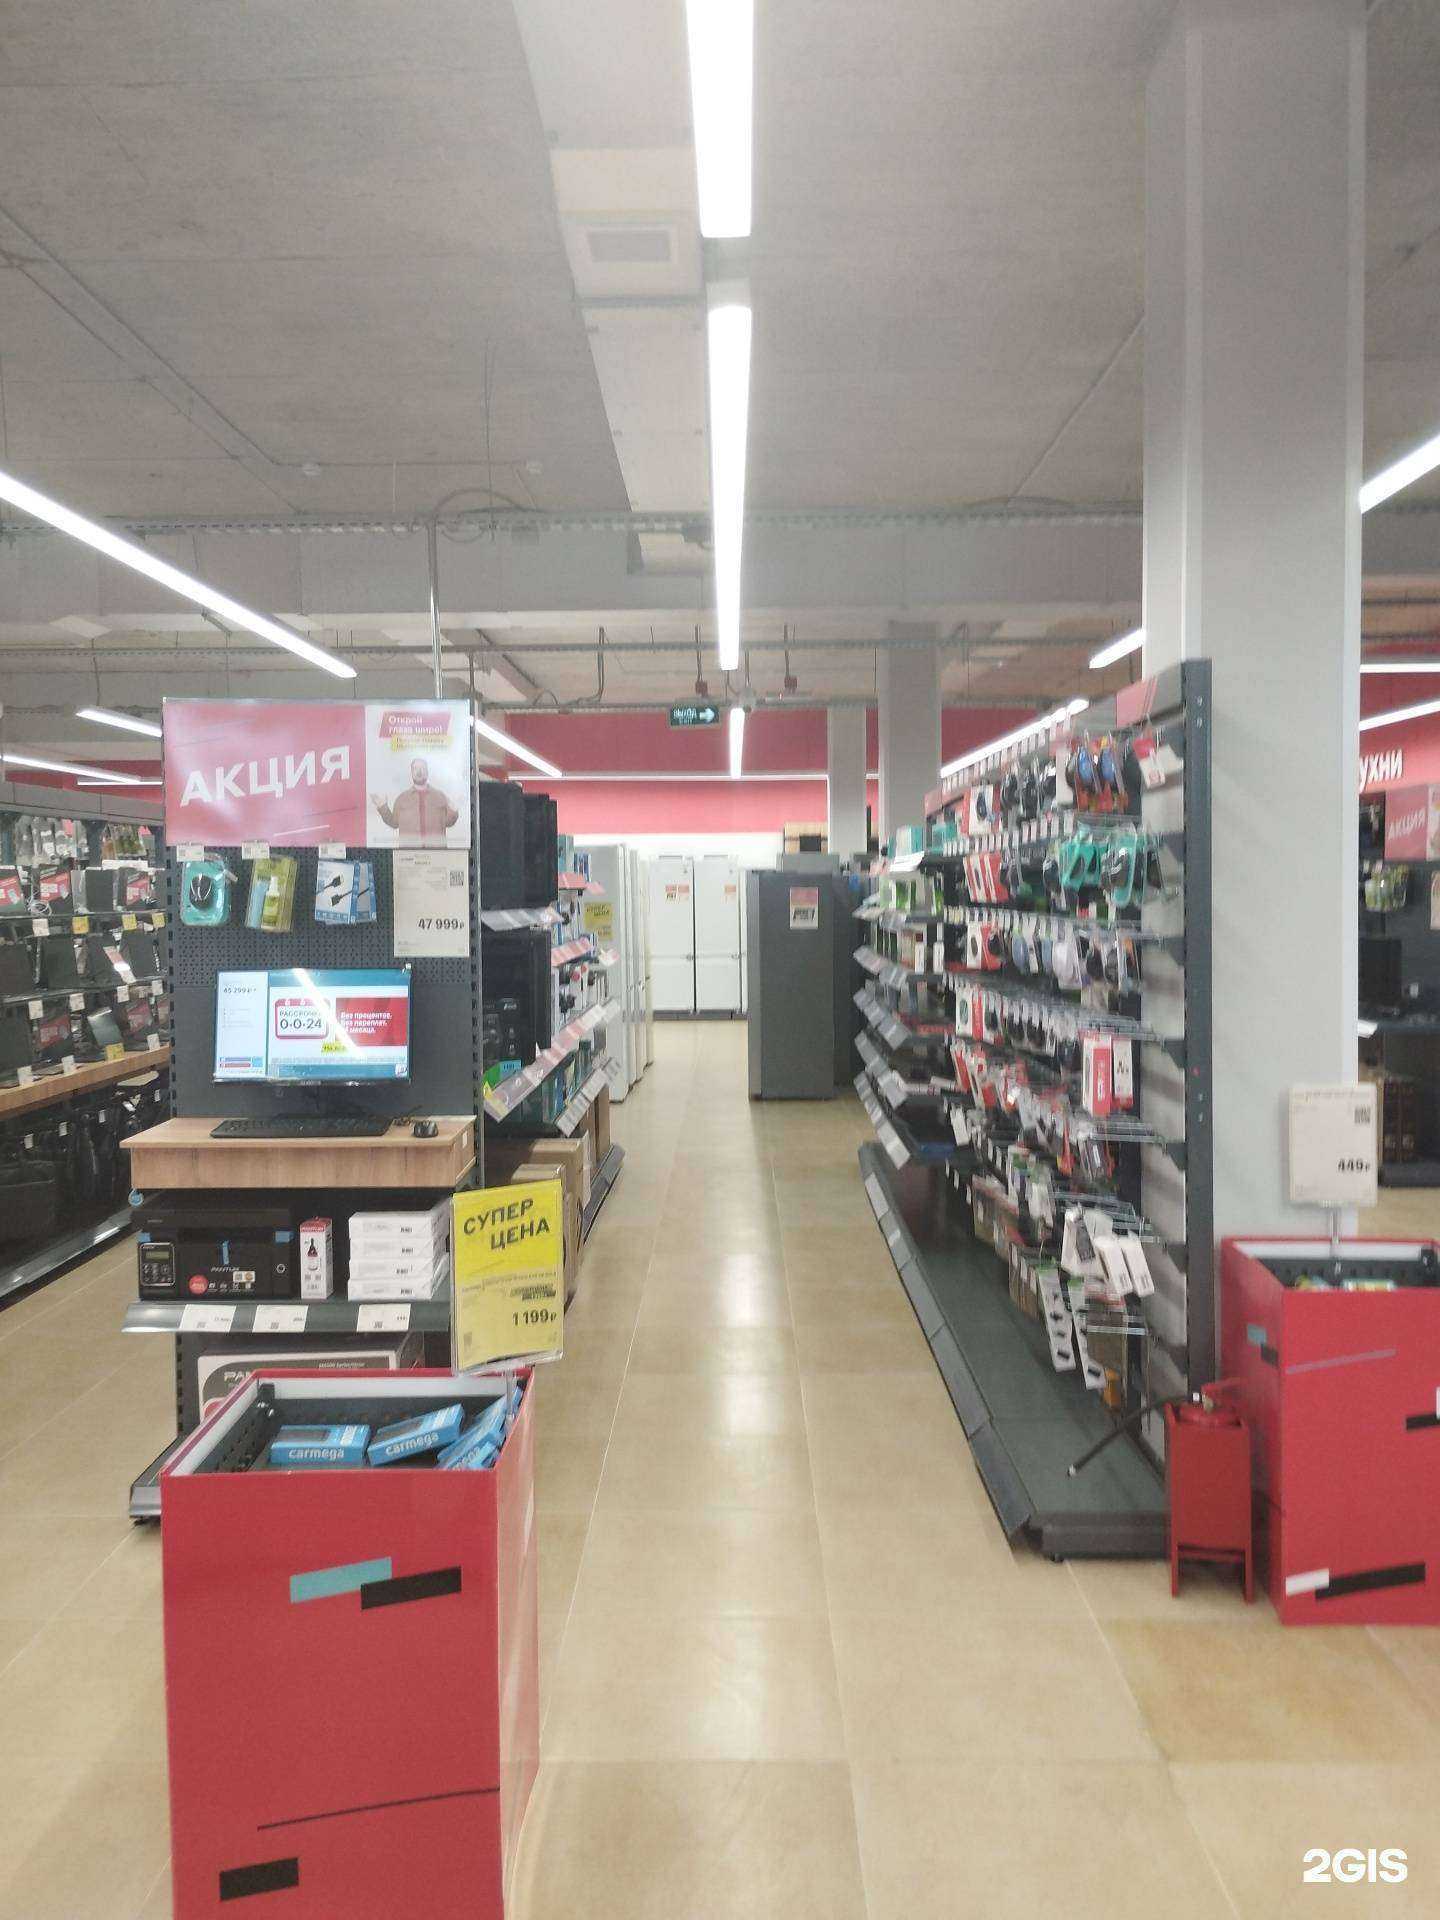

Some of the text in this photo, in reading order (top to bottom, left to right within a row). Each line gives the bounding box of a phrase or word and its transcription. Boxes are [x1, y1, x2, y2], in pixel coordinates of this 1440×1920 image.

[180, 745, 350, 808] АКЦИЯ
[1388, 807, 1426, 839] АКЦИЯ
[463, 1198, 534, 1236] СУПЕР
[490, 1218, 550, 1251] ЦЕНА
[288, 1447, 345, 1461] carmega
[385, 1431, 439, 1457] carmega
